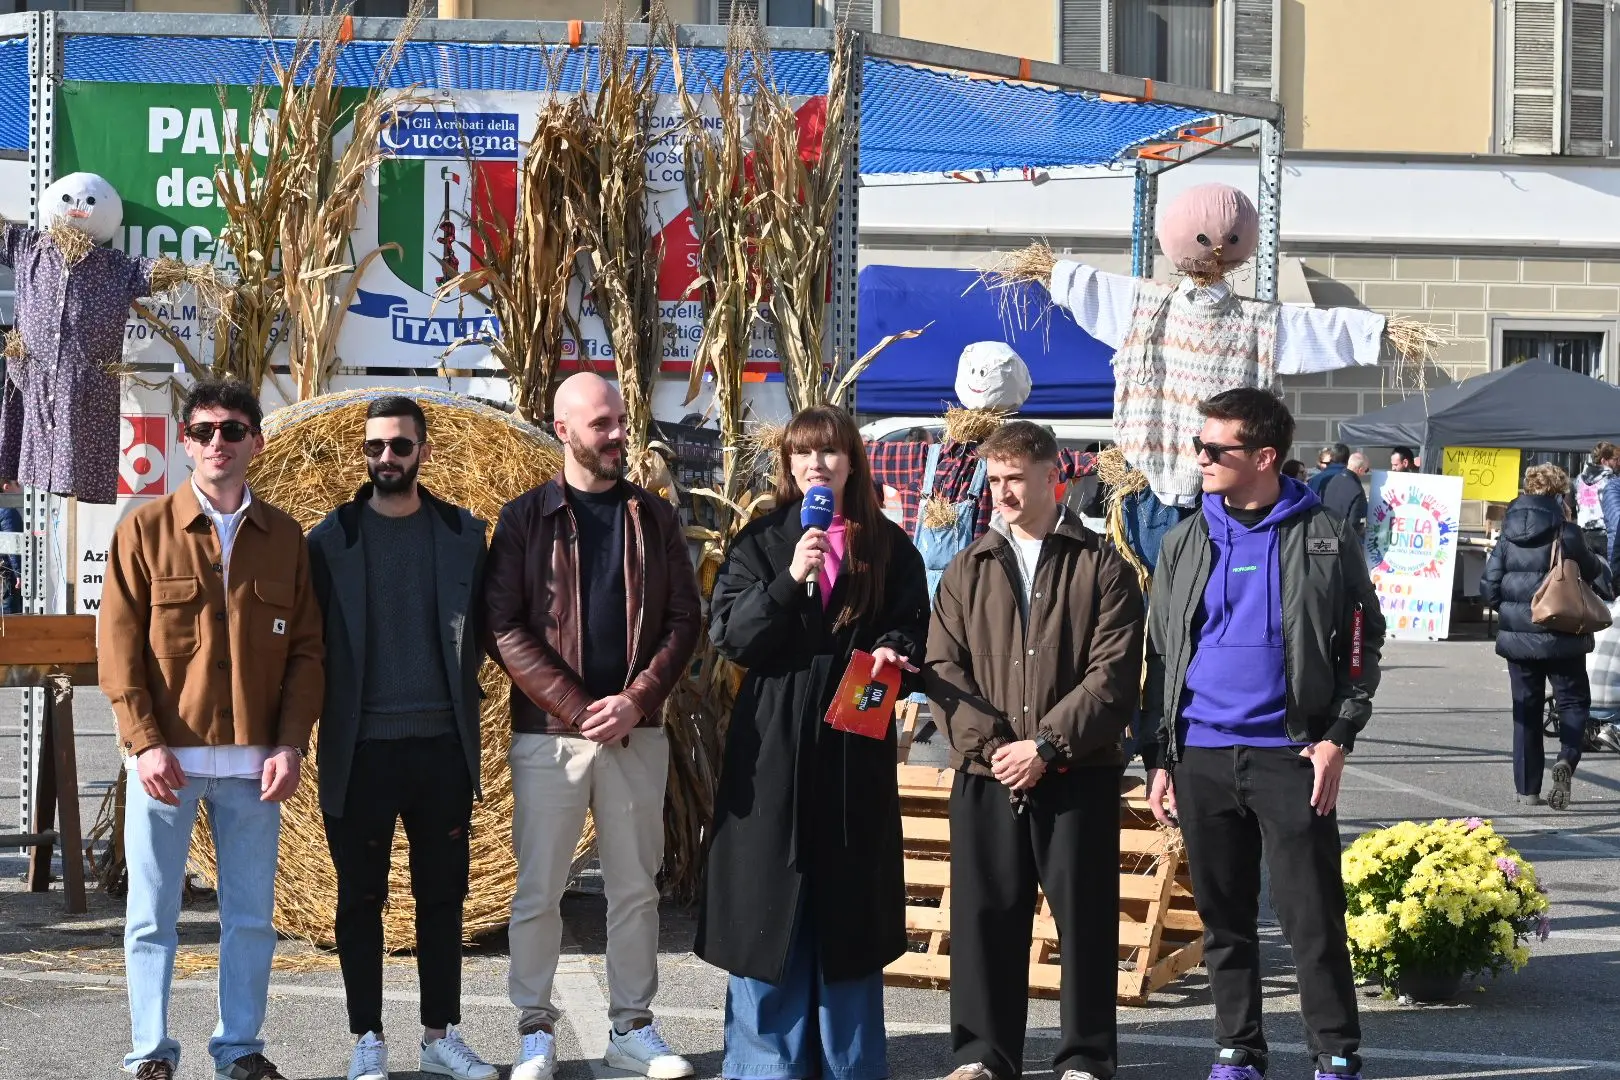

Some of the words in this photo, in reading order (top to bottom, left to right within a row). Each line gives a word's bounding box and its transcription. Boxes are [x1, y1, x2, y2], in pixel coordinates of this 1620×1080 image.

[412, 117, 431, 129] Gli
[434, 118, 484, 131] Acrobati
[487, 119, 516, 131] della
[381, 116, 517, 156] Cuccagna
[396, 317, 497, 343] ITALIA
[1446, 450, 1470, 463] VIN
